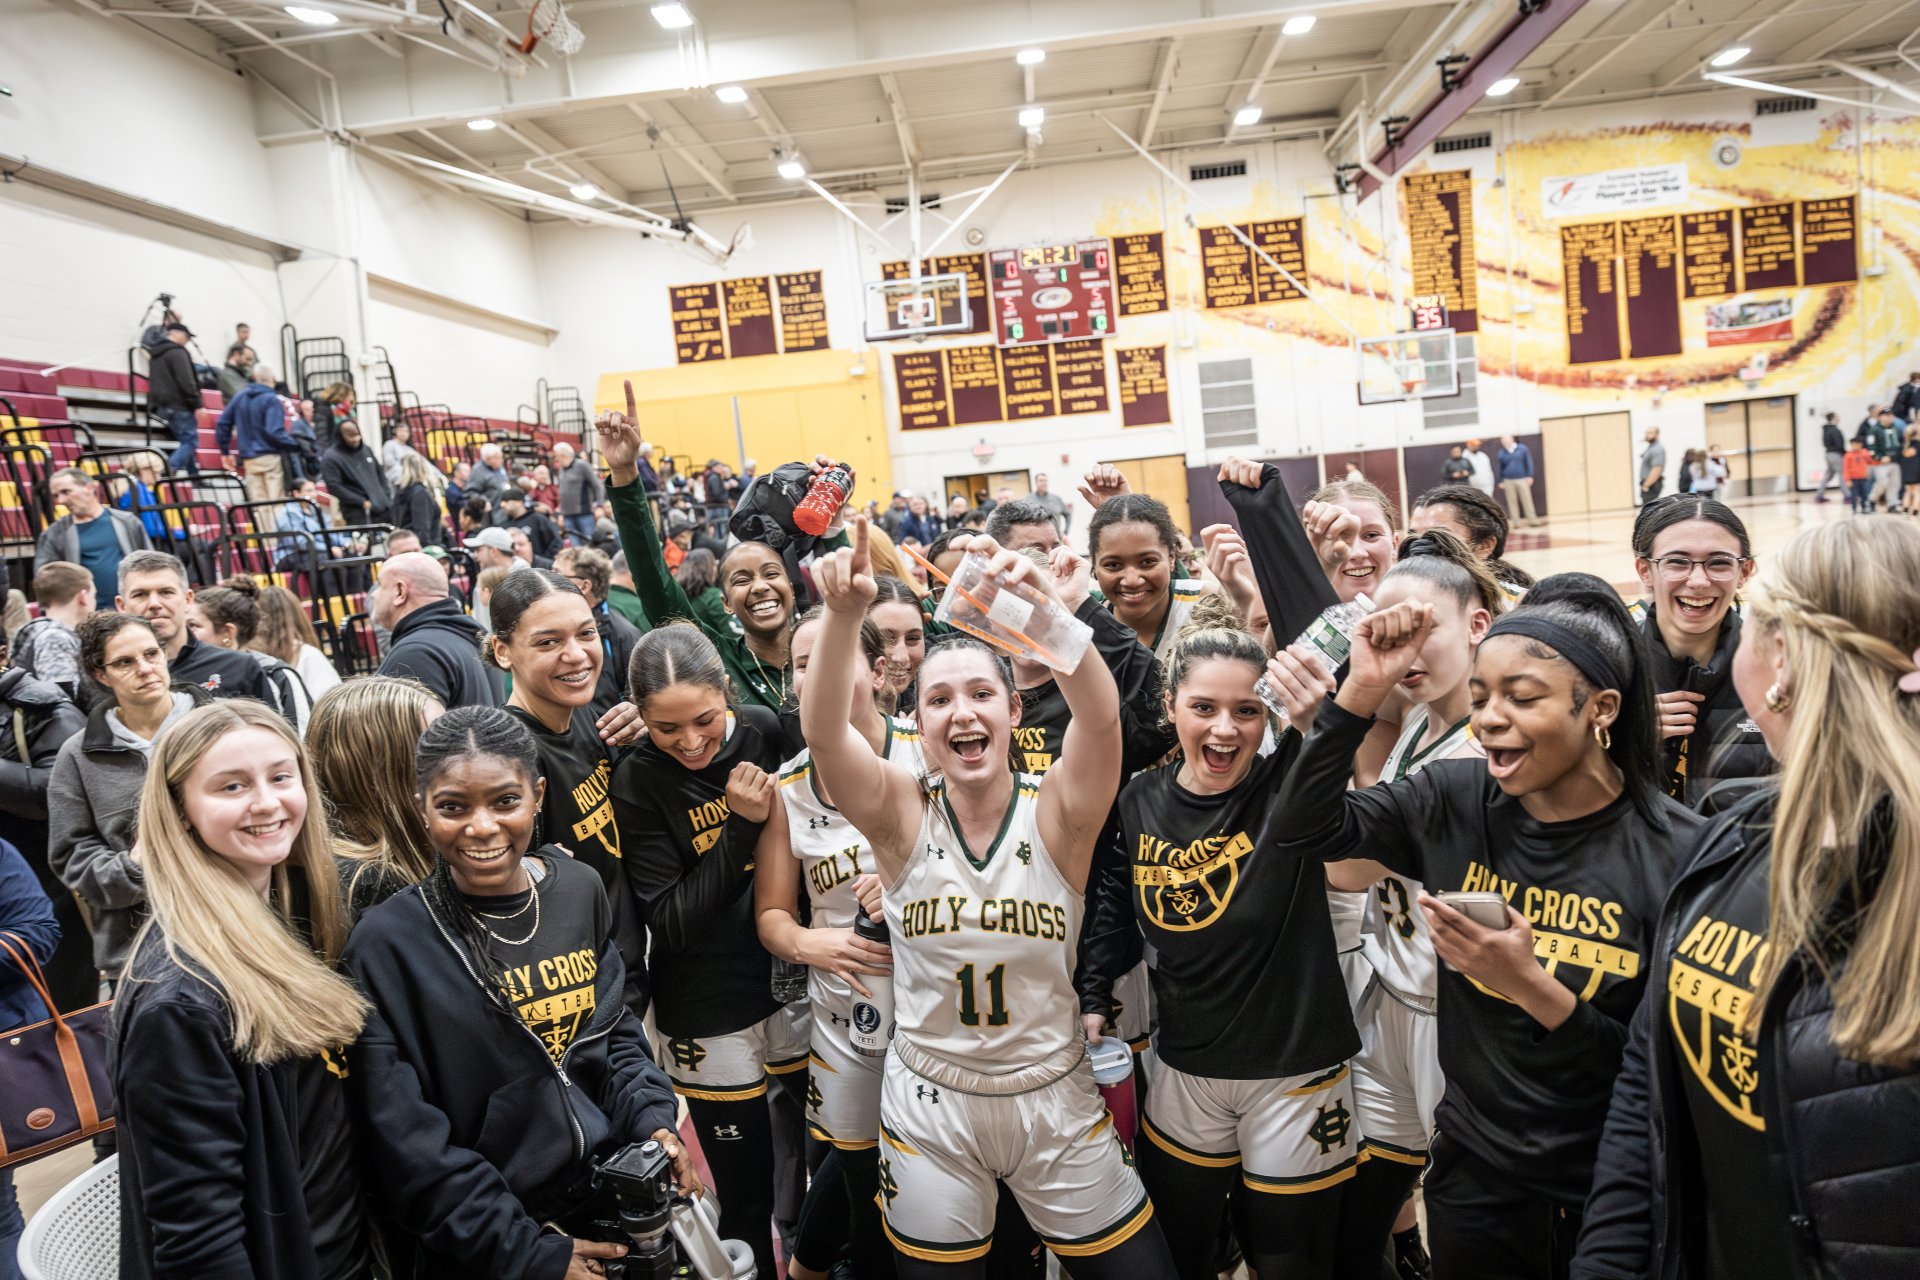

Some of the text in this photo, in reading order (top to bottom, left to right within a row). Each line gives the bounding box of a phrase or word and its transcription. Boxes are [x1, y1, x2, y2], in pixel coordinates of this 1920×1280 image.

[1005, 251, 1108, 279] 0 0
[1021, 244, 1077, 268] 29:21
[1416, 307, 1443, 330] 35
[1060, 385, 1106, 401] CHAMPIONS
[572, 773, 607, 815] HOLY
[810, 844, 863, 896] HOLY
[902, 896, 1067, 942] HOLY CROSS
[1523, 886, 1623, 940] CROSS
[1677, 915, 1763, 977] HOLY
[537, 948, 598, 991] CROSS
[954, 962, 1011, 1028] 11
[856, 1034, 875, 1045] YETI
